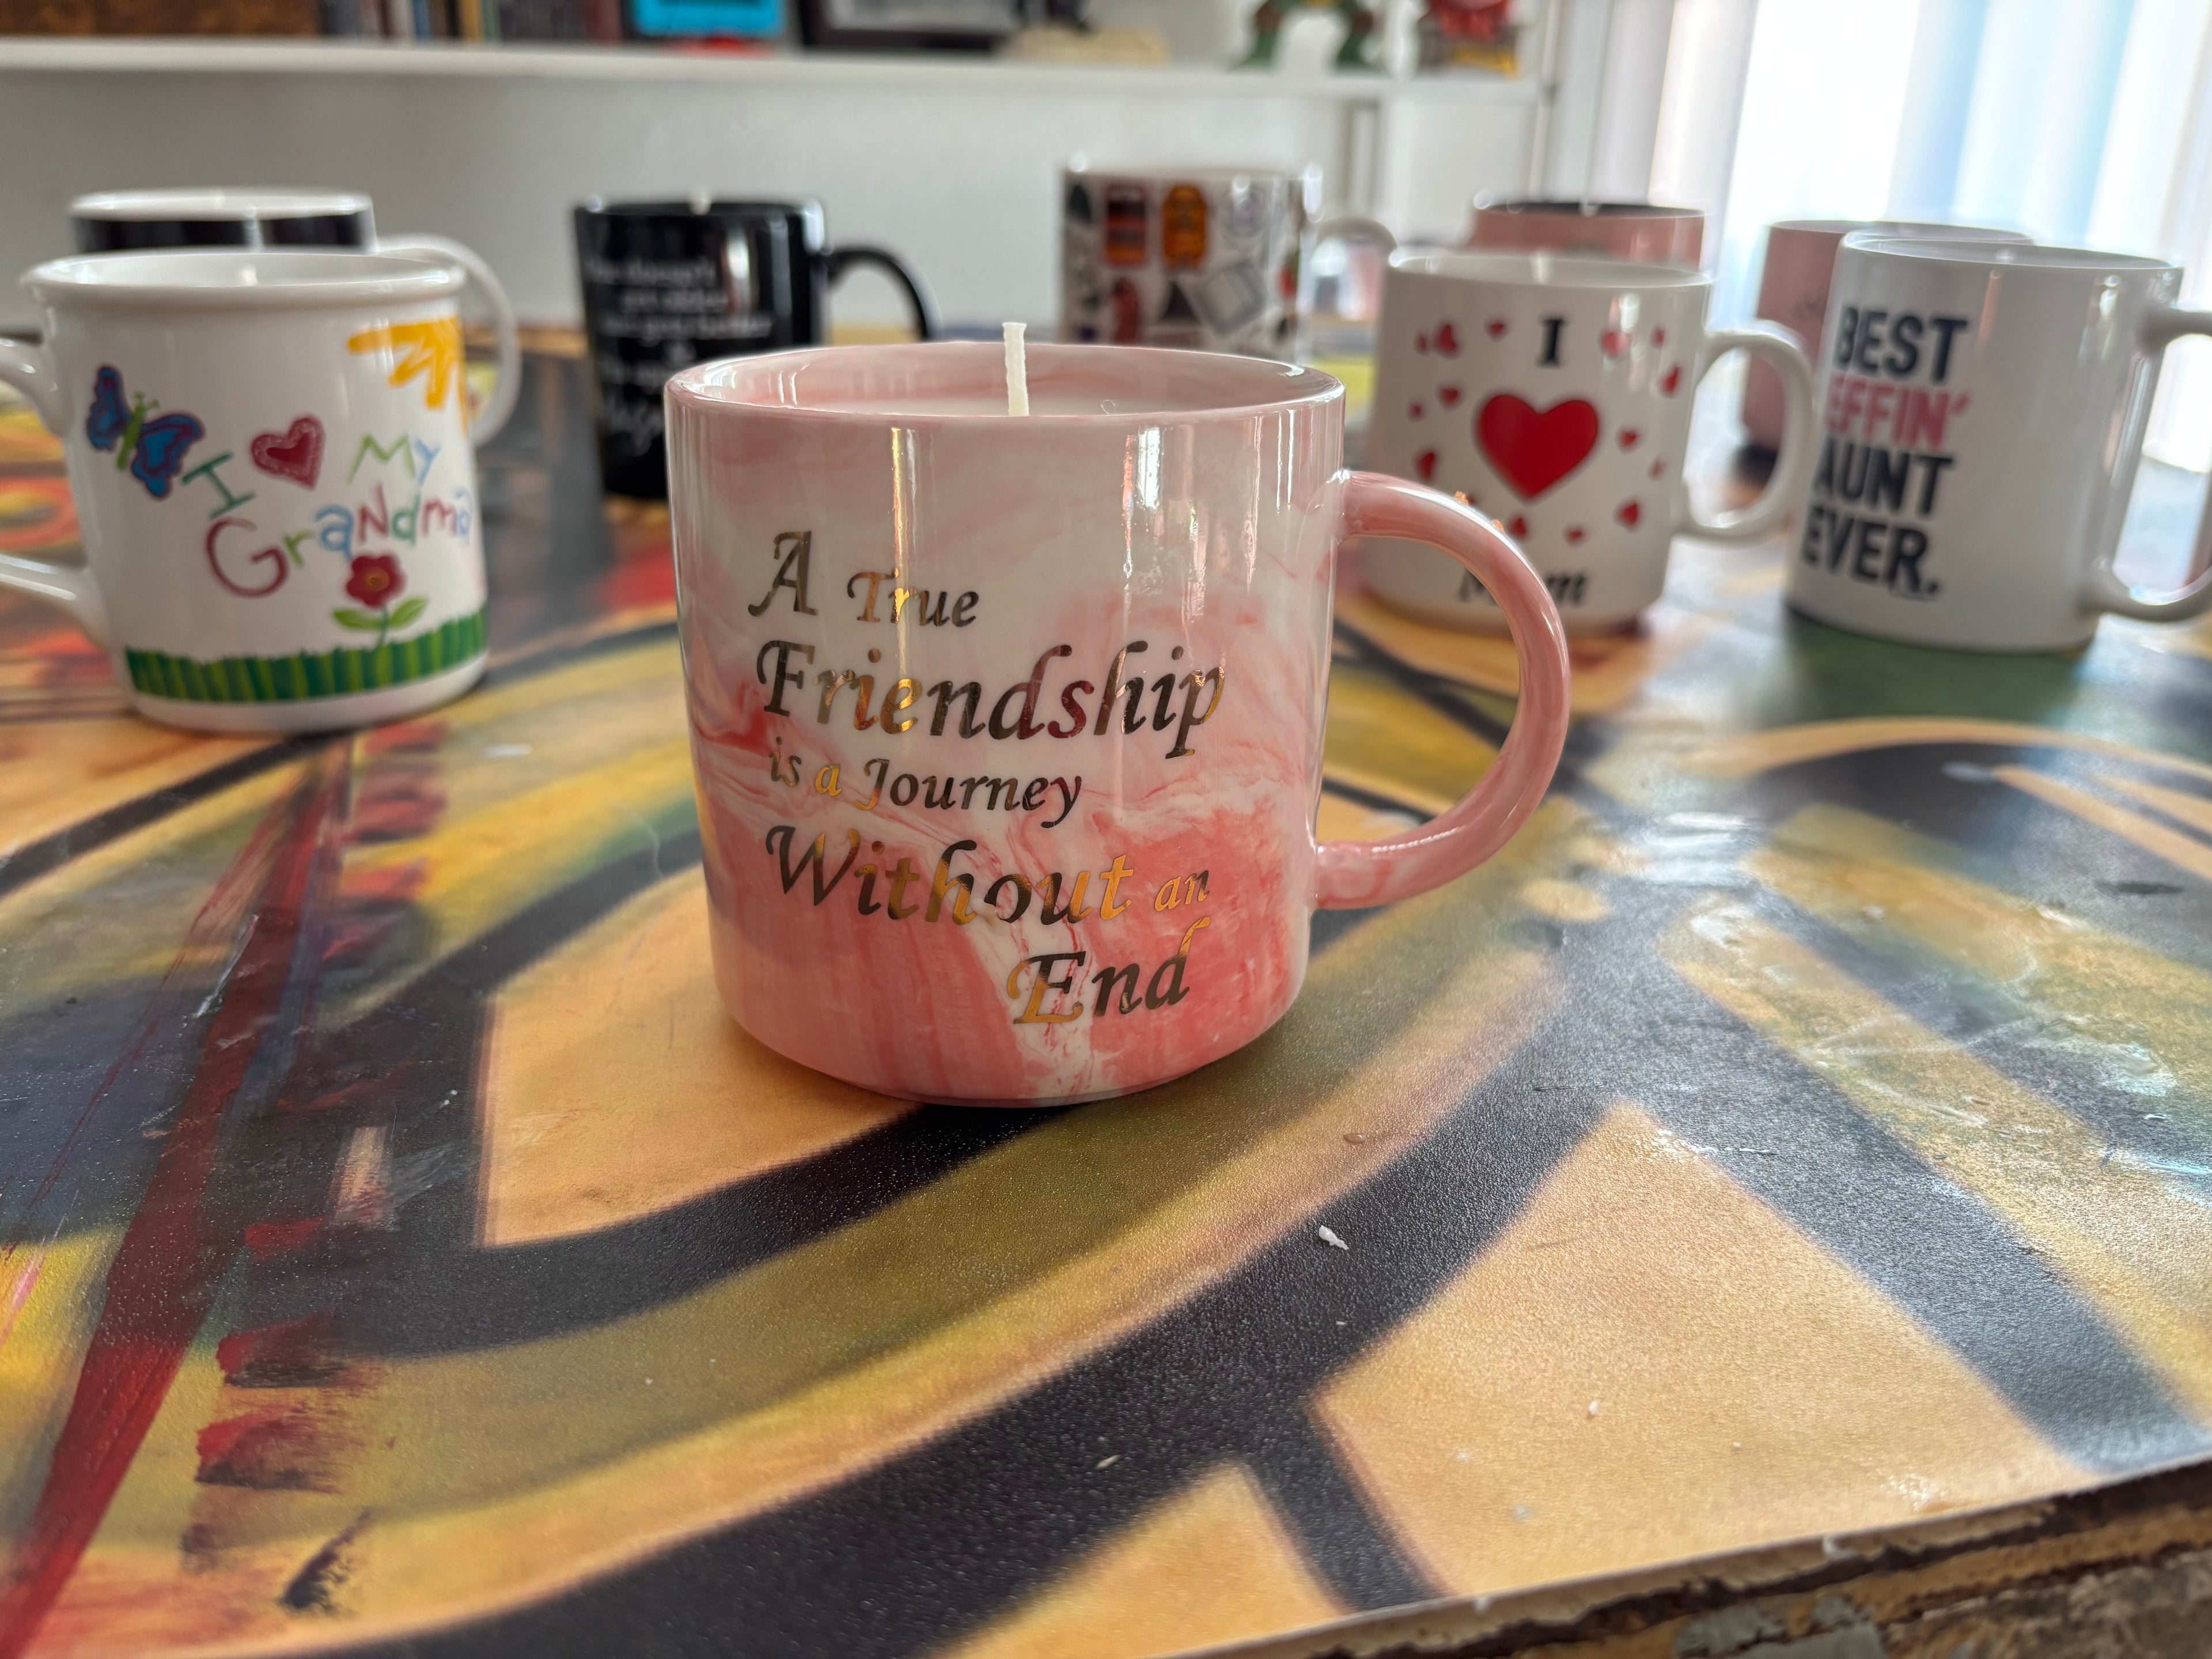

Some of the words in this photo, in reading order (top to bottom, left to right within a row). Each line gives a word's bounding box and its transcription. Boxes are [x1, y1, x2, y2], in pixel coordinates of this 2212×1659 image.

[1537, 316, 1566, 368] I
[1836, 306, 1968, 384] BEST
[1826, 372, 1971, 452] EFFIN'
[181, 451, 257, 520] I
[347, 434, 442, 487] My
[1812, 436, 1954, 517] AUNT
[748, 531, 818, 618] A
[847, 568, 980, 627] True
[1801, 501, 1941, 595] EVER.
[756, 640, 1226, 760] Friendship
[769, 737, 802, 788] is
[815, 759, 842, 797] a
[855, 758, 1083, 828] Journey
[765, 825, 1135, 926] Without
[1154, 869, 1210, 913] an
[1007, 917, 1211, 1025] End
